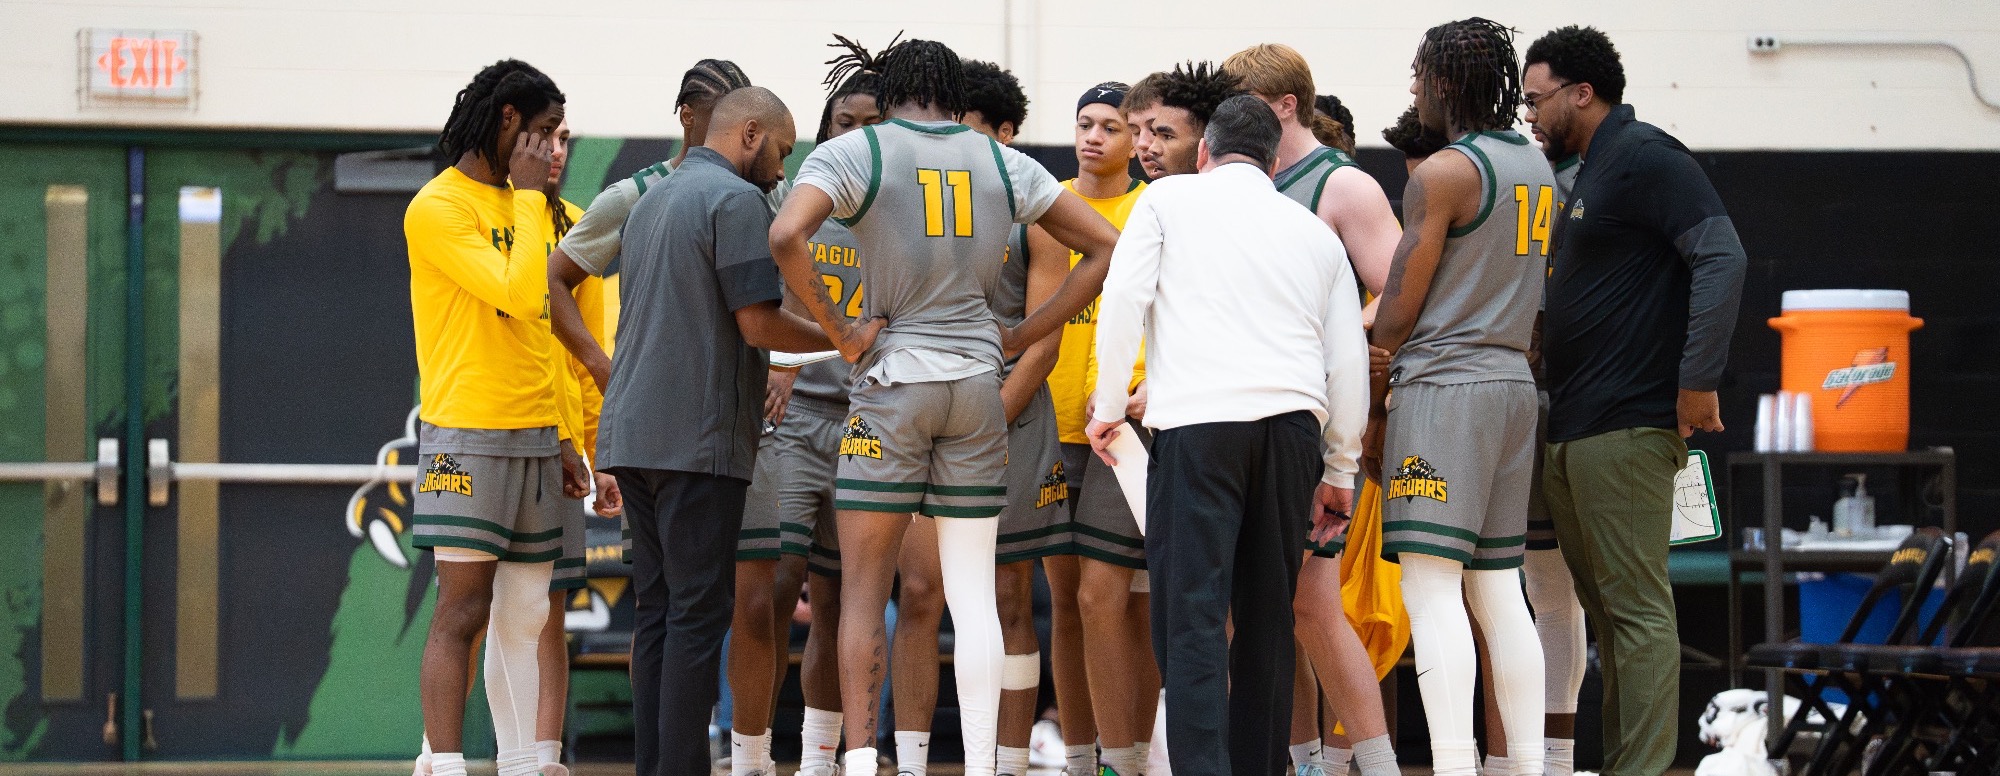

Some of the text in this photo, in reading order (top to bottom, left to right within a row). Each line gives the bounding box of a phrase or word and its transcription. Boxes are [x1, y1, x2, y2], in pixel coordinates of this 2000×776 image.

[110, 37, 178, 88] EXIT
[916, 167, 974, 238] 11
[1514, 184, 1553, 256] 14
[807, 242, 861, 268] AGU
[1387, 478, 1448, 503] JAGUARS
